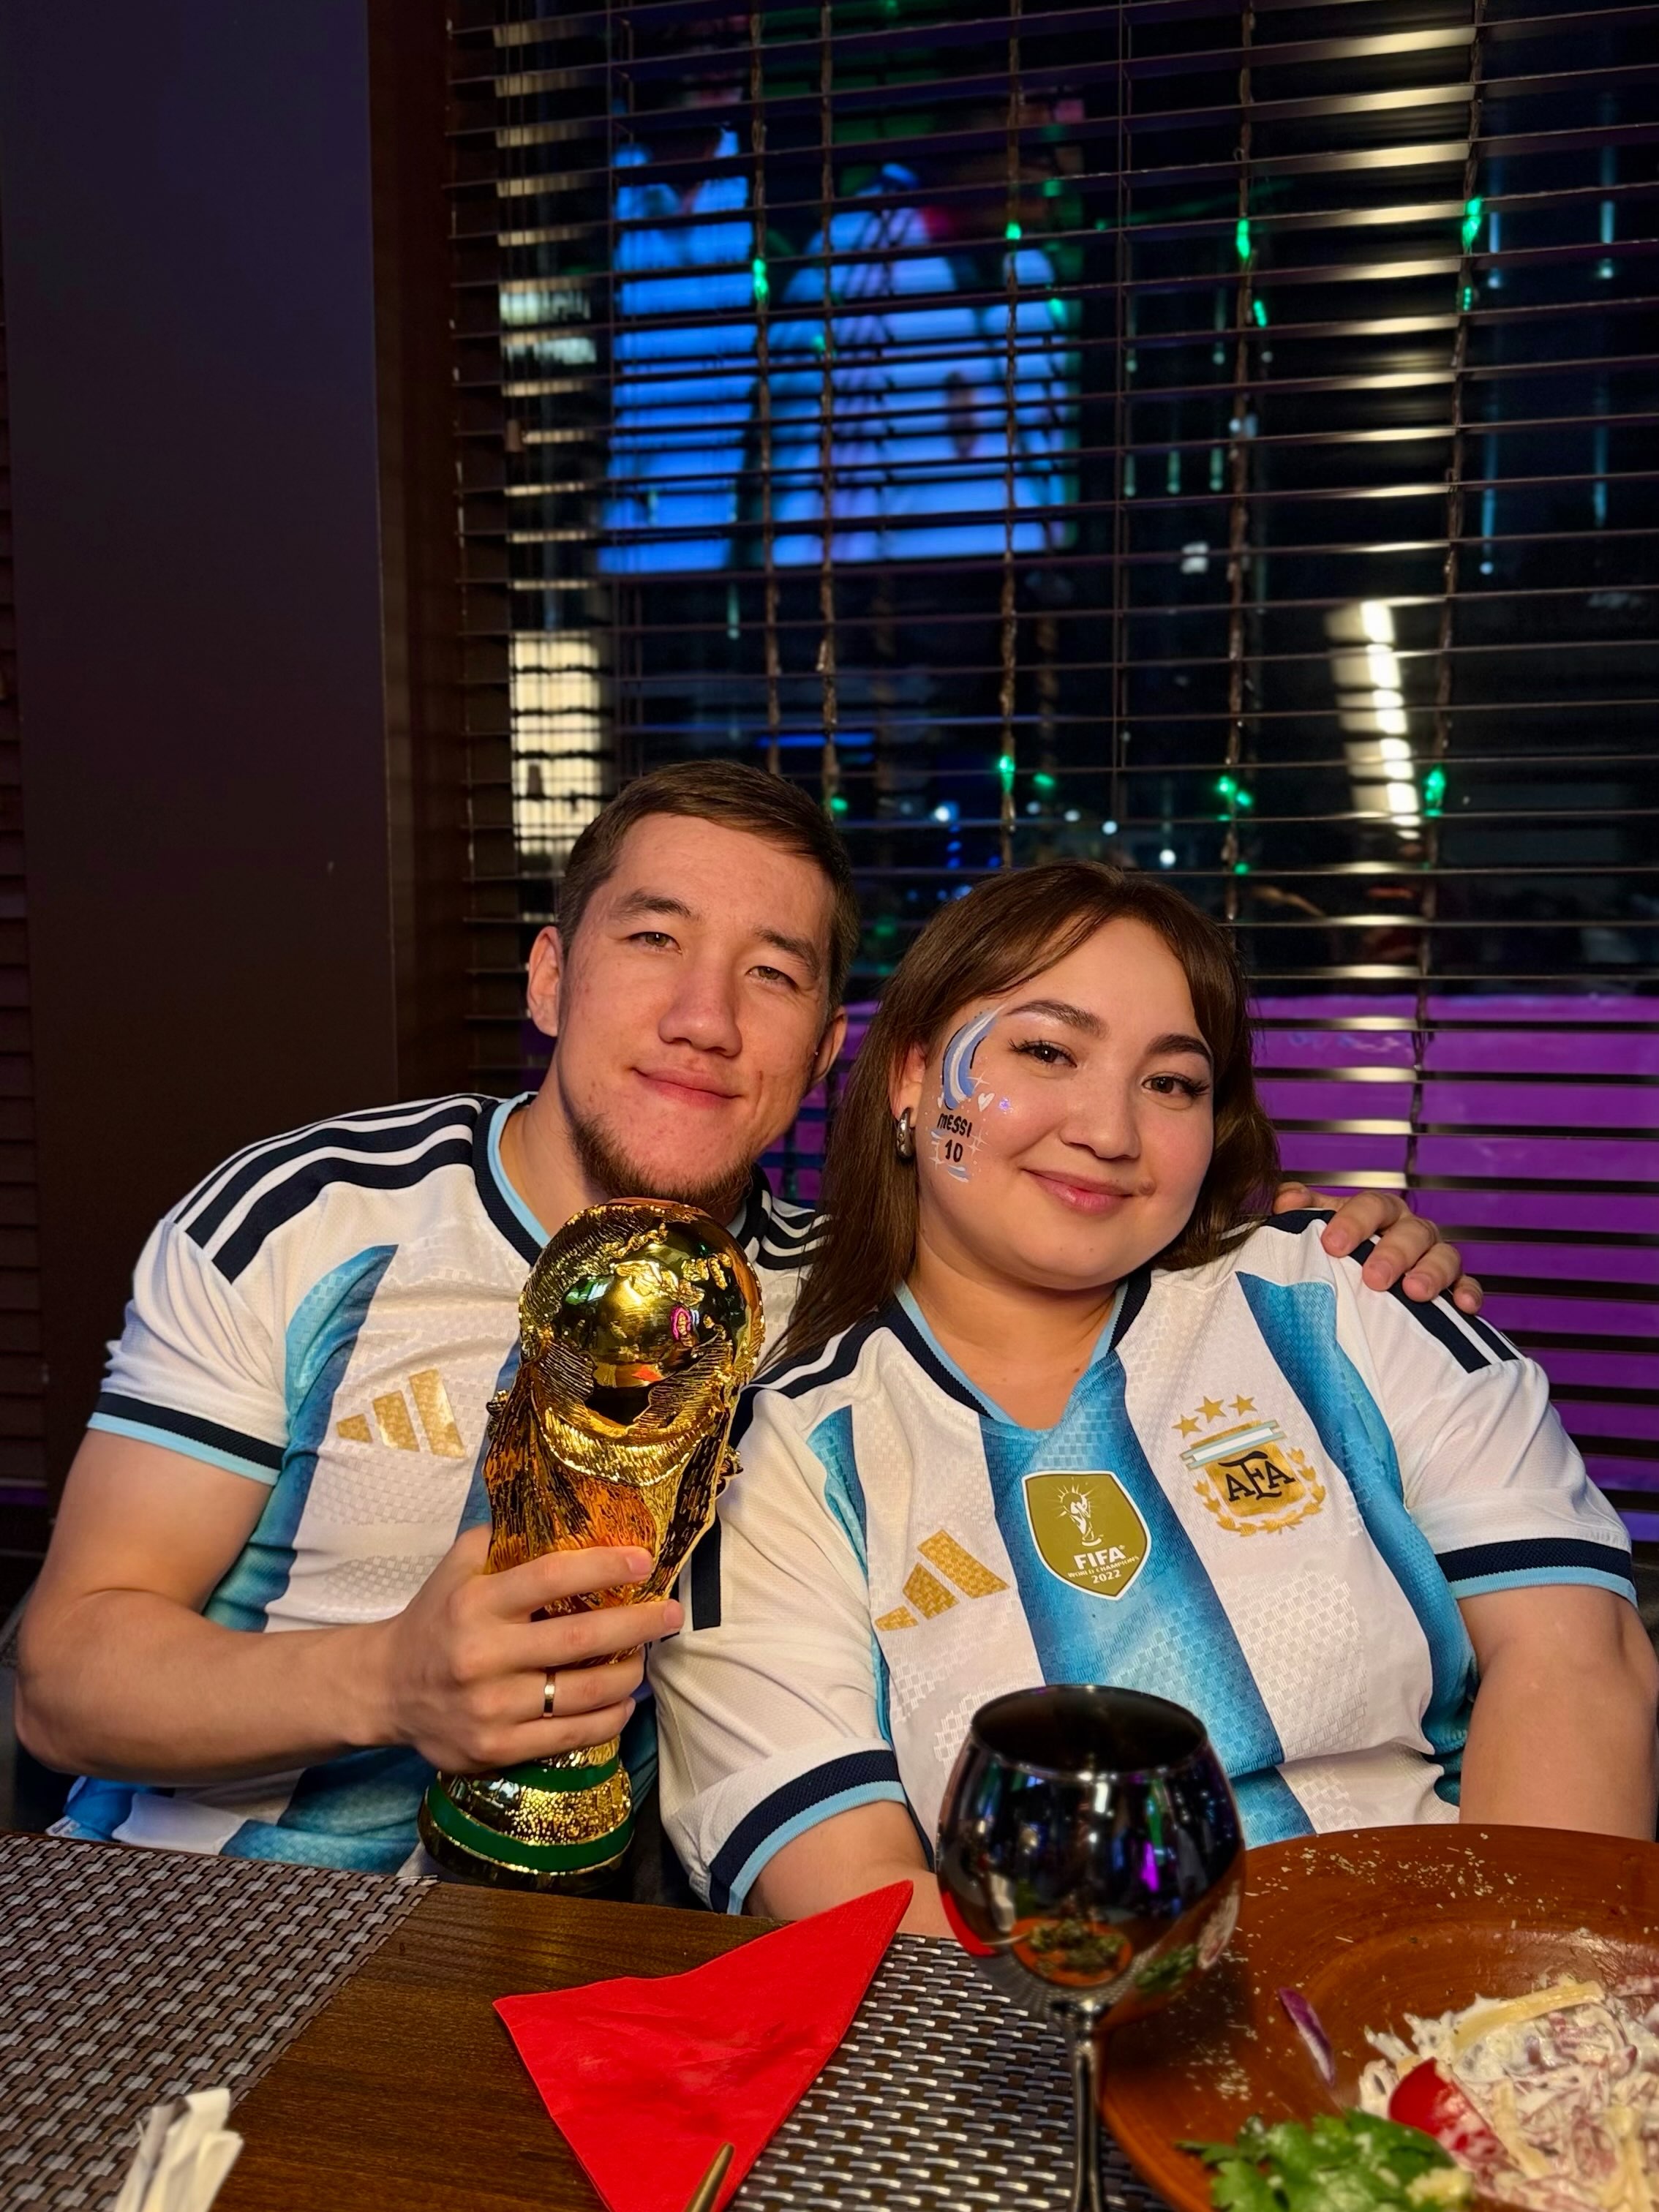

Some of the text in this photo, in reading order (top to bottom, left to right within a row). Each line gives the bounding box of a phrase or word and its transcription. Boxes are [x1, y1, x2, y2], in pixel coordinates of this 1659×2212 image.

[937, 1113, 972, 1138] MESSI
[944, 1139, 963, 1162] 10
[1218, 1451, 1296, 1502] AFA
[1091, 1569, 1122, 1584] 2022
